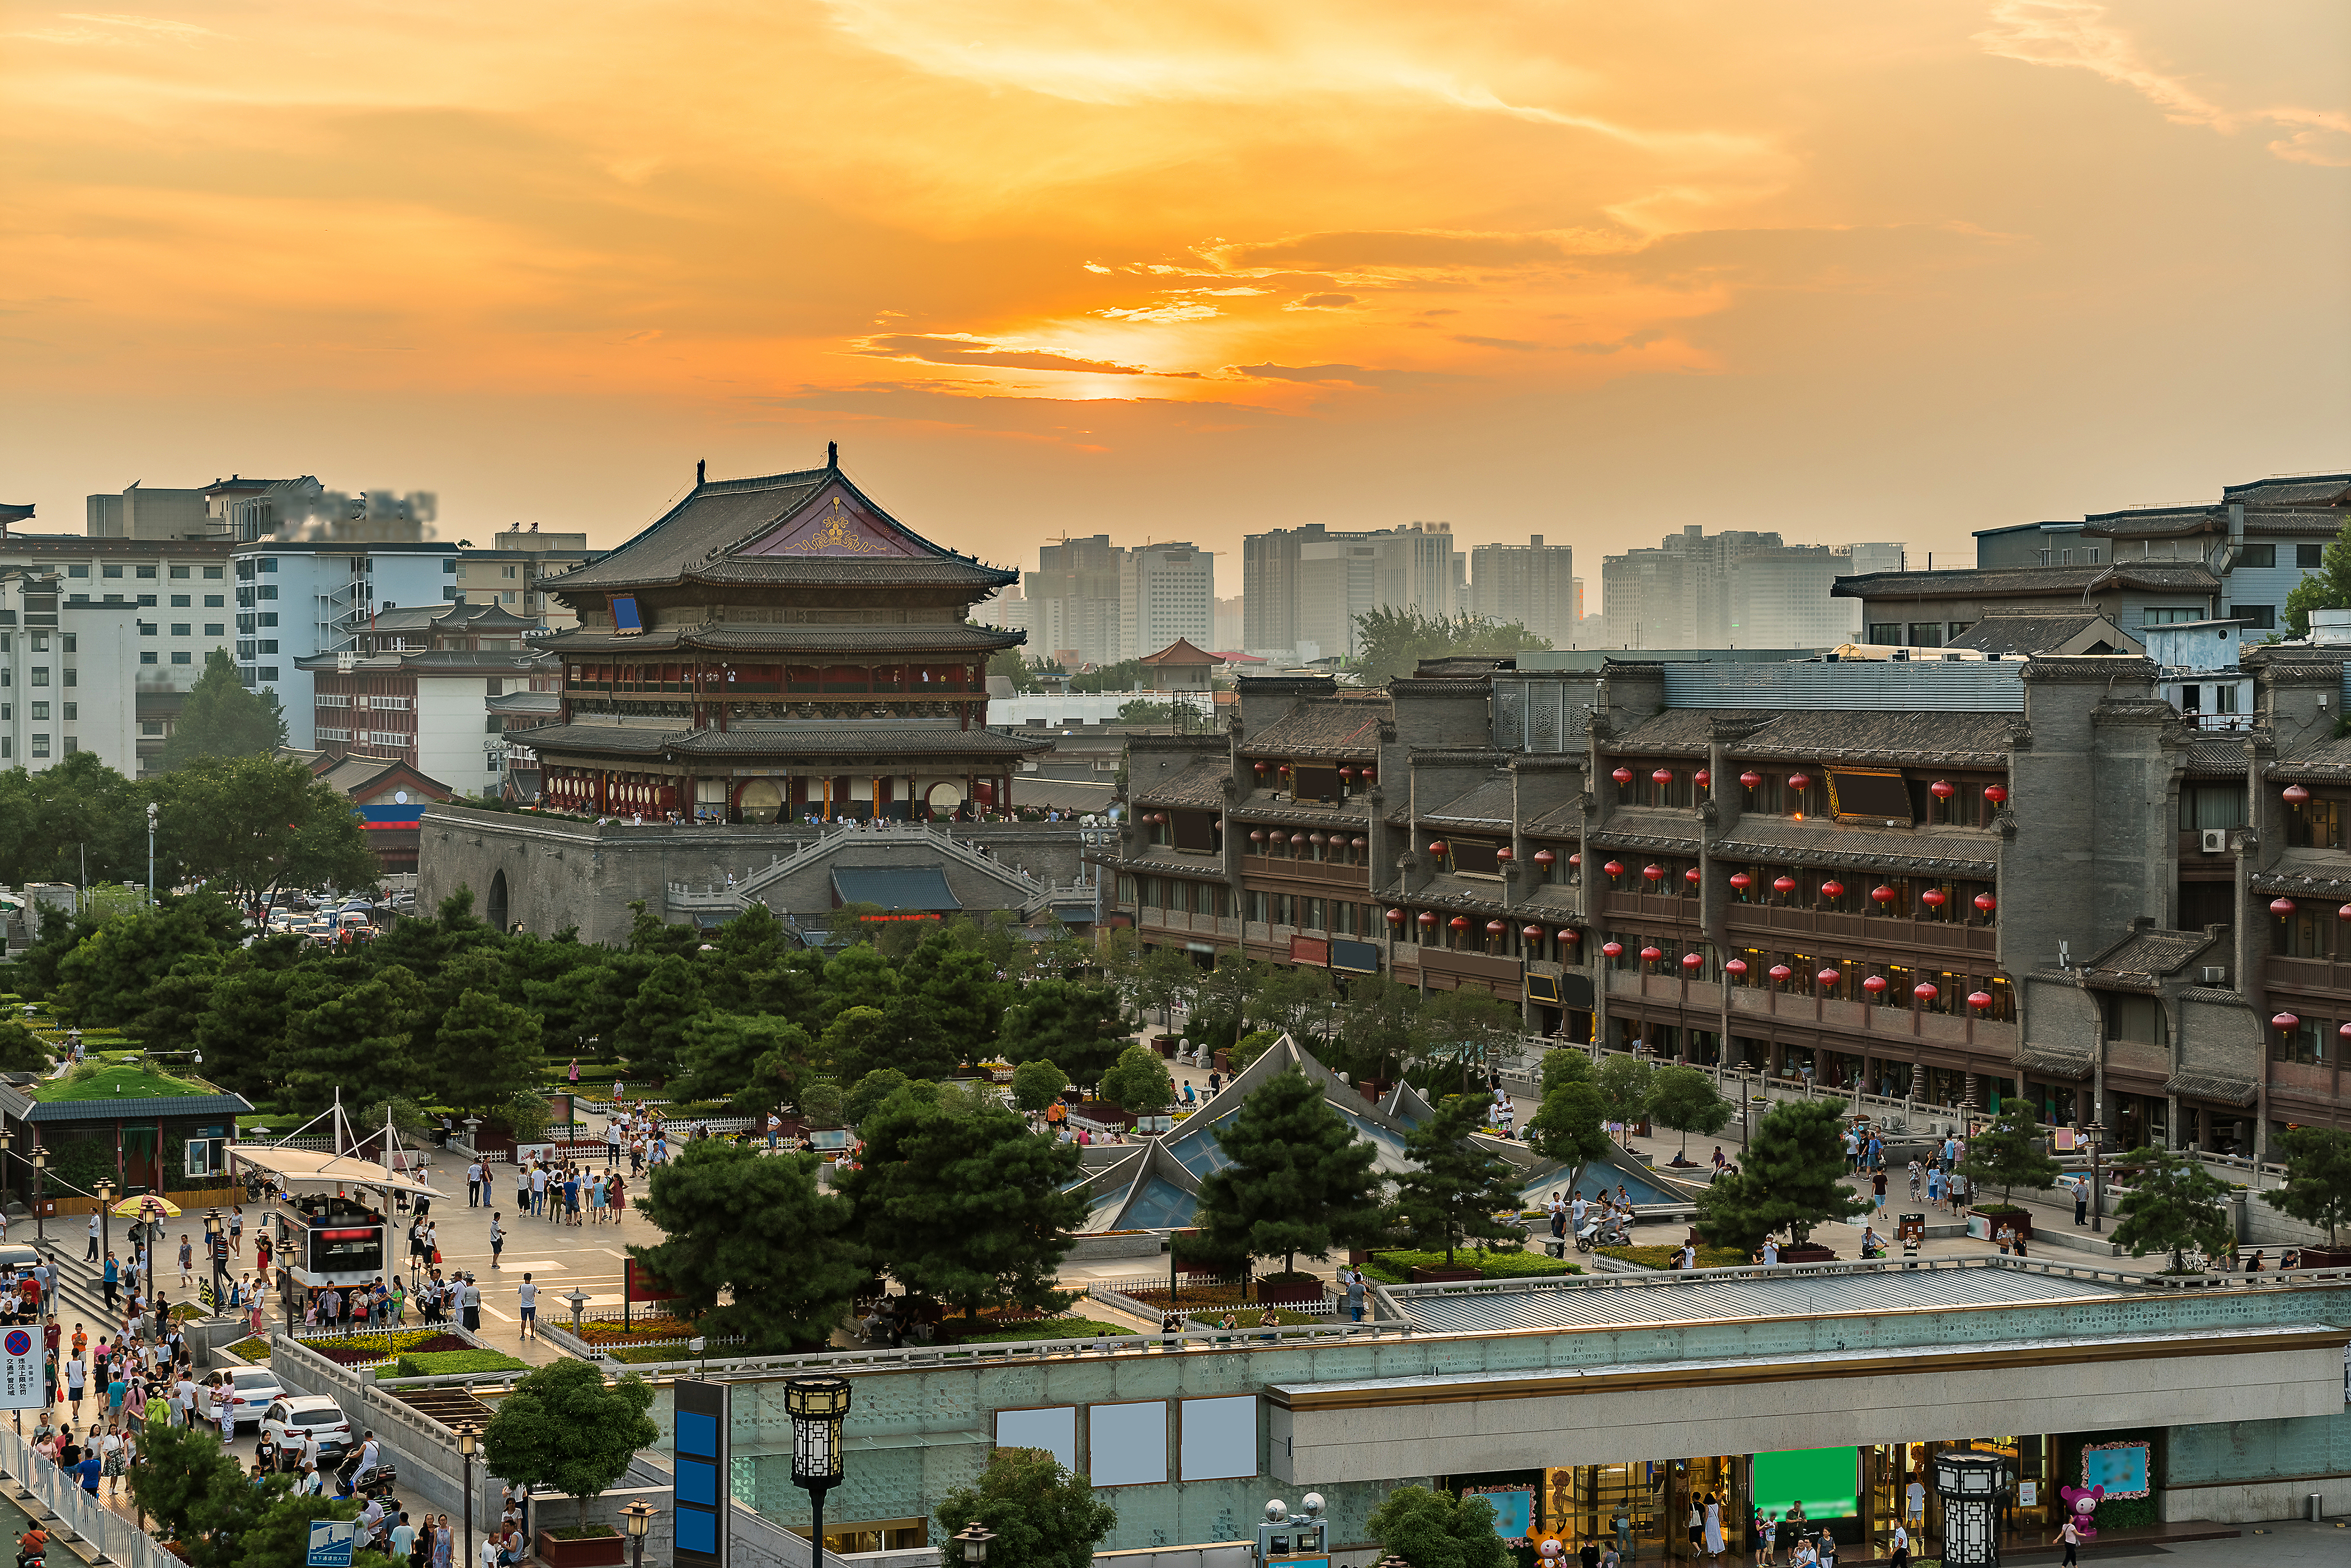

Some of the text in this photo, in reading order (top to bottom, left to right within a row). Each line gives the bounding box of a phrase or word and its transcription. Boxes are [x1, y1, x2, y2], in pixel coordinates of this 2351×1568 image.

[331, 914, 335, 924] P
[6, 1359, 15, 1396] 交通严管区域
[18, 1358, 27, 1396] 违法上限处罚
